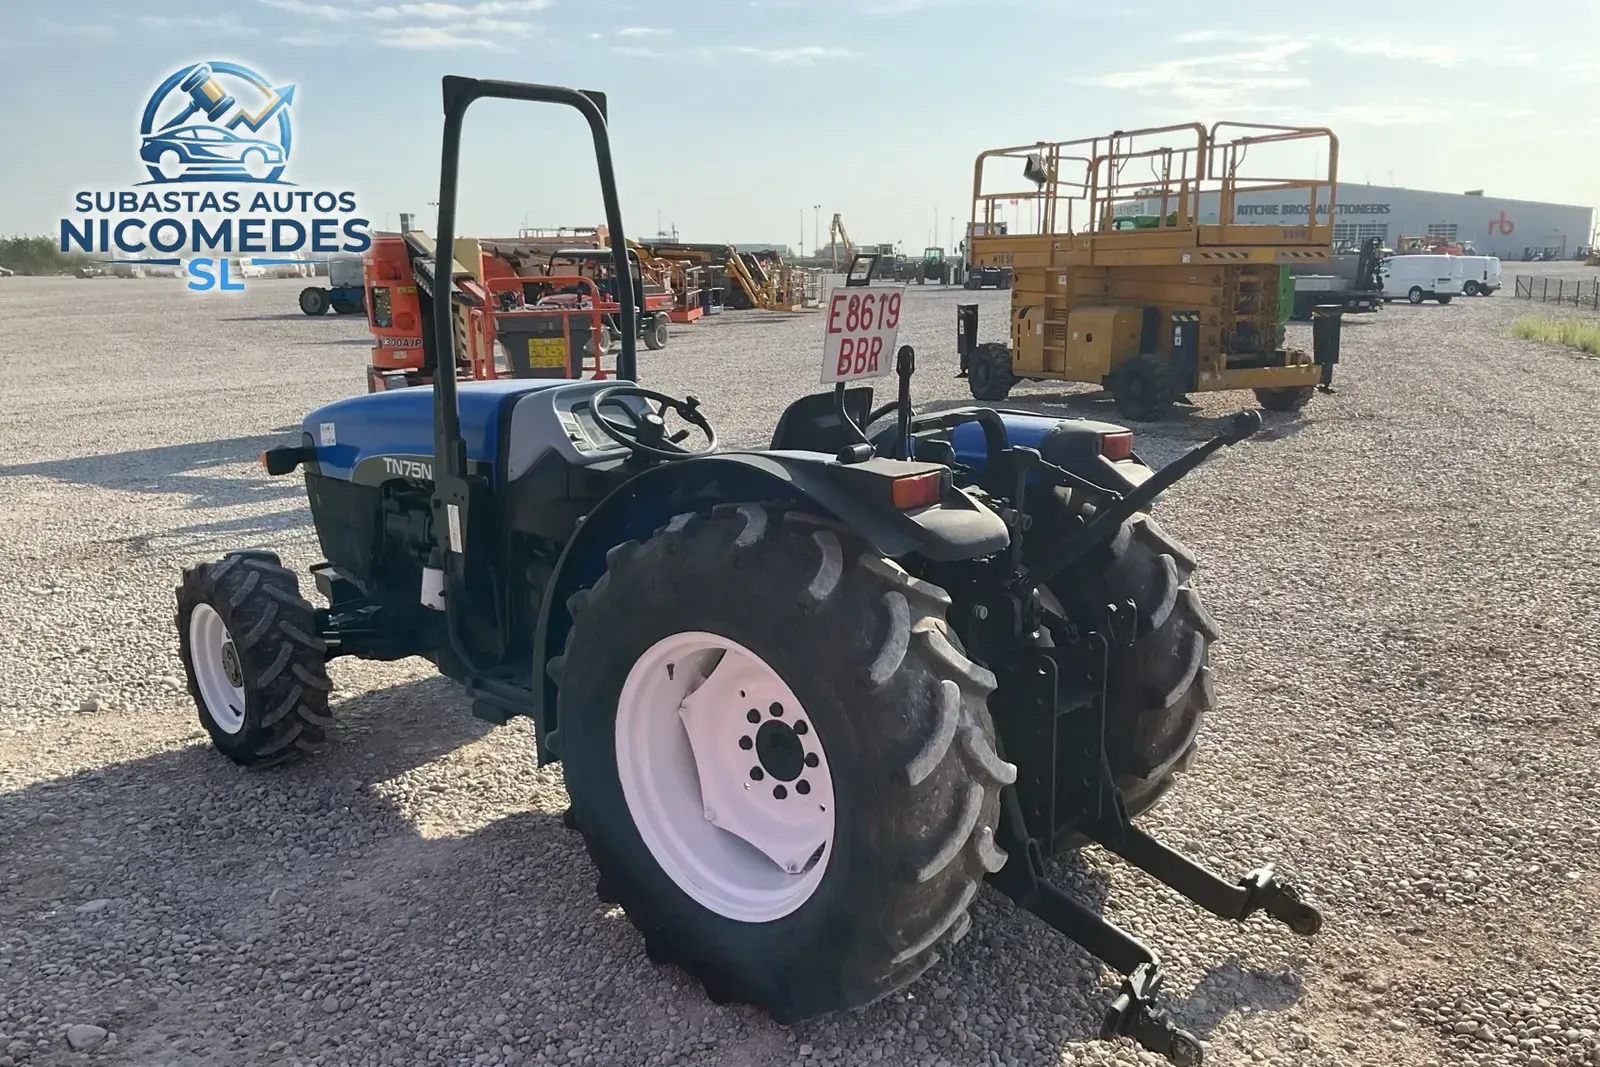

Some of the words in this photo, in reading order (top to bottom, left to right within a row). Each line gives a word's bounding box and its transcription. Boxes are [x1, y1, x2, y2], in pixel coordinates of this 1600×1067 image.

[1237, 204, 1279, 216] RITCHIE
[1487, 210, 1515, 235] rb
[828, 292, 901, 334] E8619
[836, 335, 883, 376] BBR
[382, 456, 433, 481] TN75N
